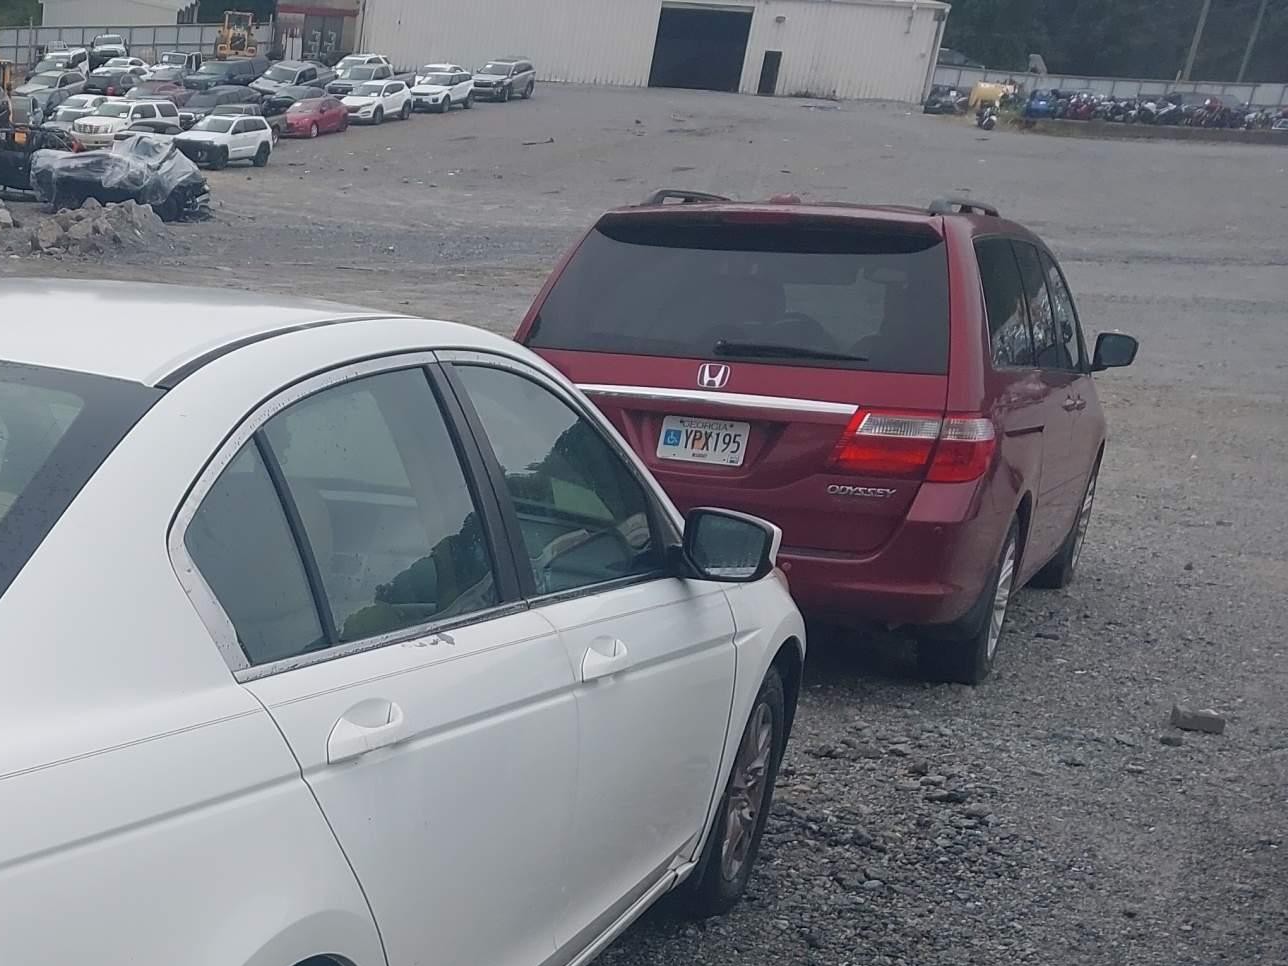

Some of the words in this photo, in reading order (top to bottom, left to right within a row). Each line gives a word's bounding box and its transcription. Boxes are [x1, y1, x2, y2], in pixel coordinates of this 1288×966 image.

[682, 420, 728, 431] GEORGIA
[684, 429, 742, 453] YPX195
[827, 485, 897, 497] ODYSSEY
